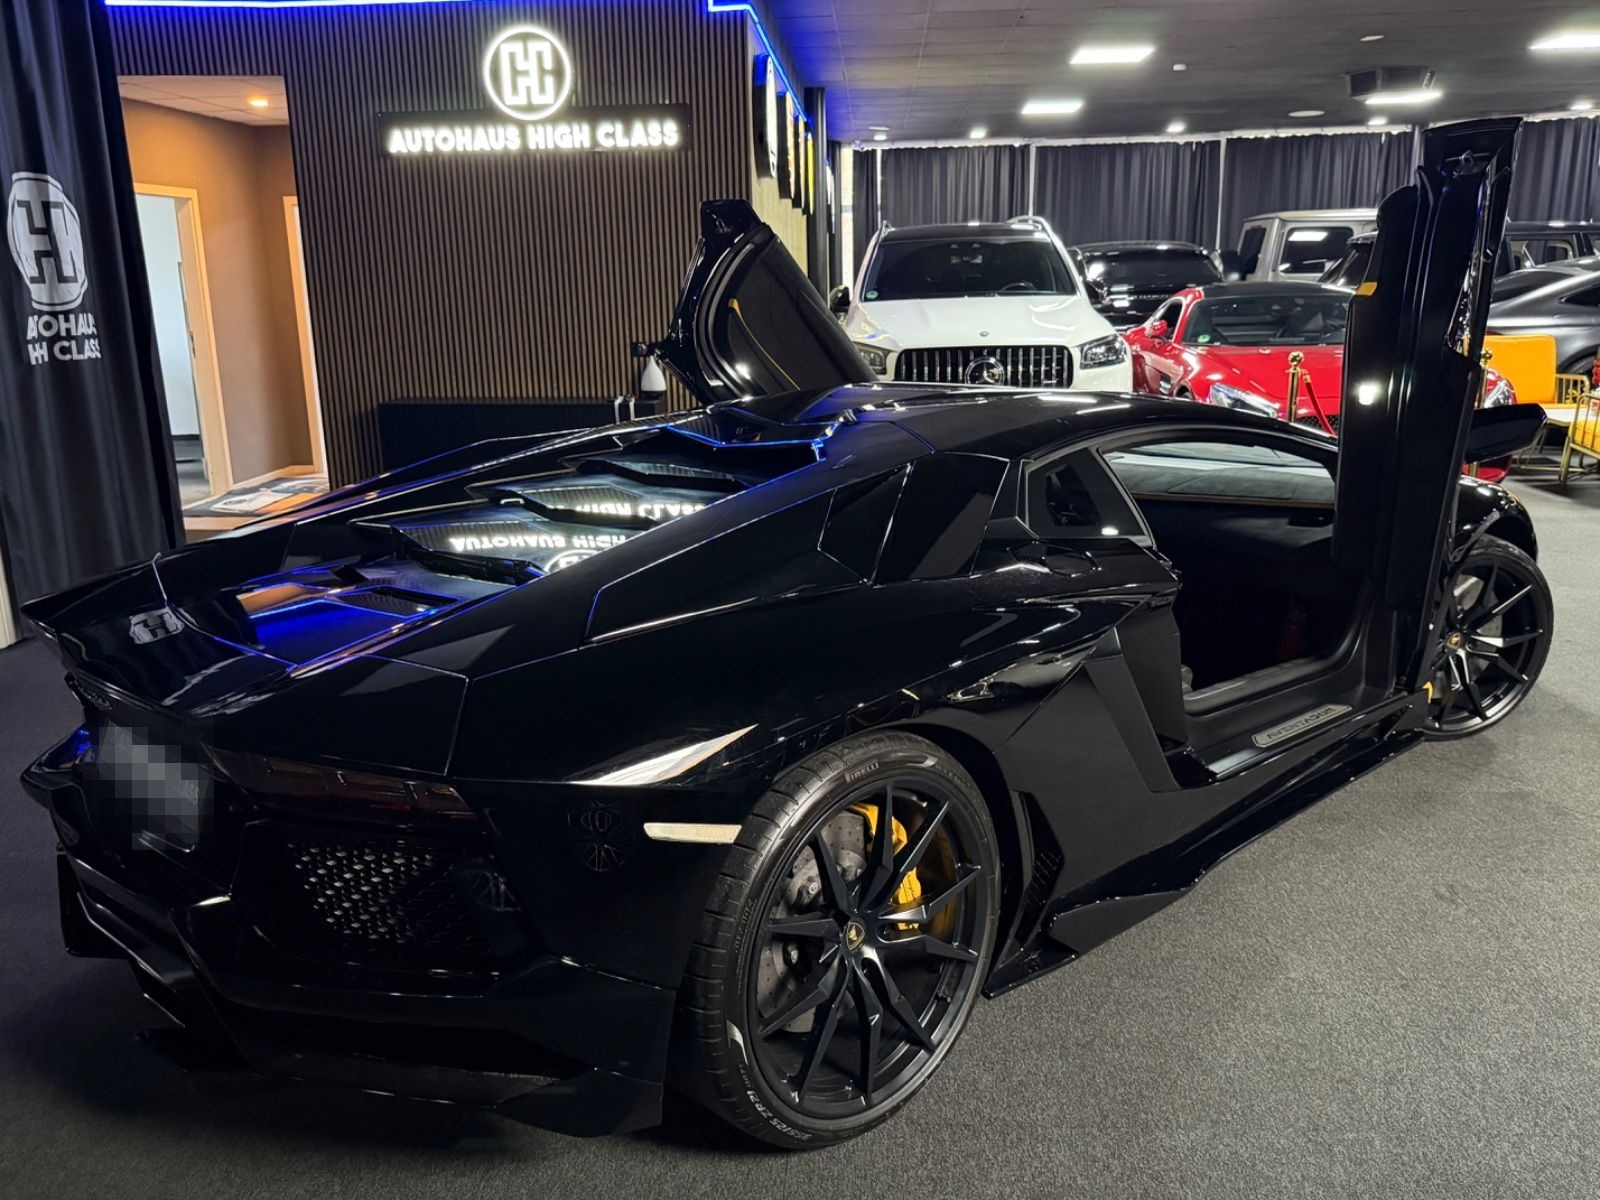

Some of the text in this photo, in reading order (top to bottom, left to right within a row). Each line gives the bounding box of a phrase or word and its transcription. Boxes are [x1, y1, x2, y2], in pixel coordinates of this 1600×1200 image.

[388, 120, 680, 153] AUTOHAUS HIGH CLASS
